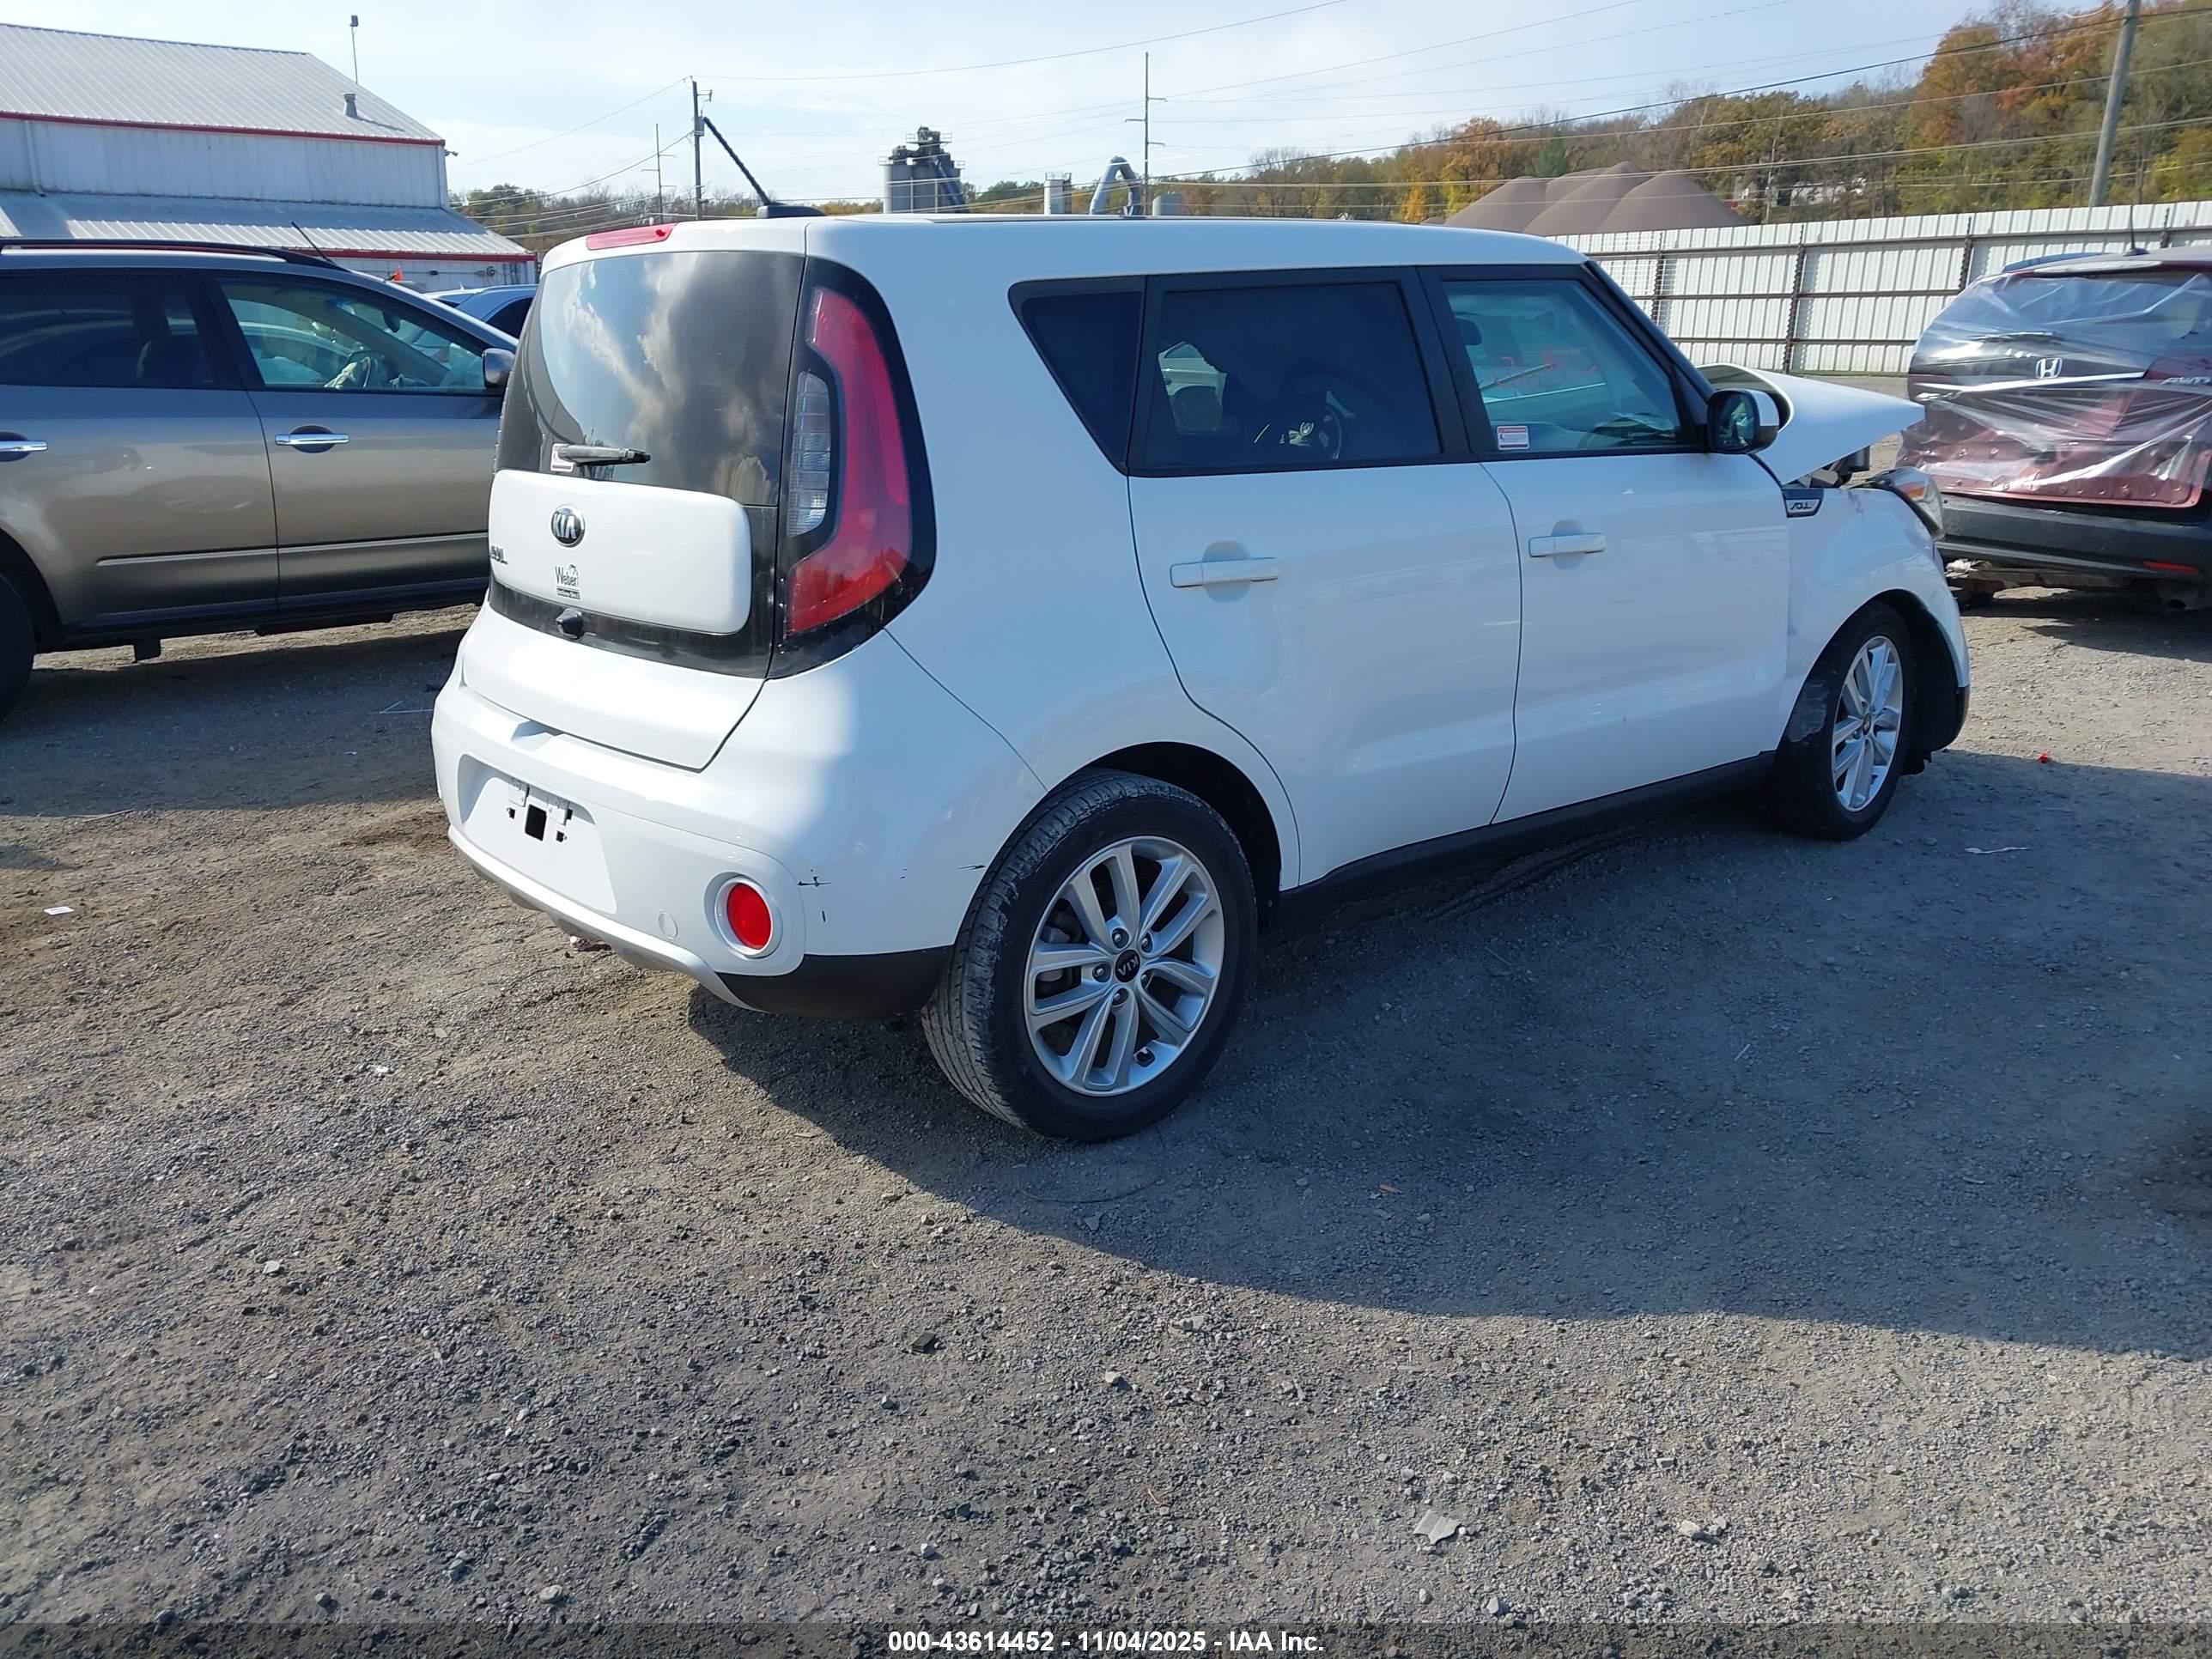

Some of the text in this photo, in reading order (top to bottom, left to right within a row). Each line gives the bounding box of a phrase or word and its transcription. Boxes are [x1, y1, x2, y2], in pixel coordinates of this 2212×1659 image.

[553, 513, 577, 539] KIA
[555, 564, 579, 586] Weber
[1118, 956, 1139, 976] KIA
